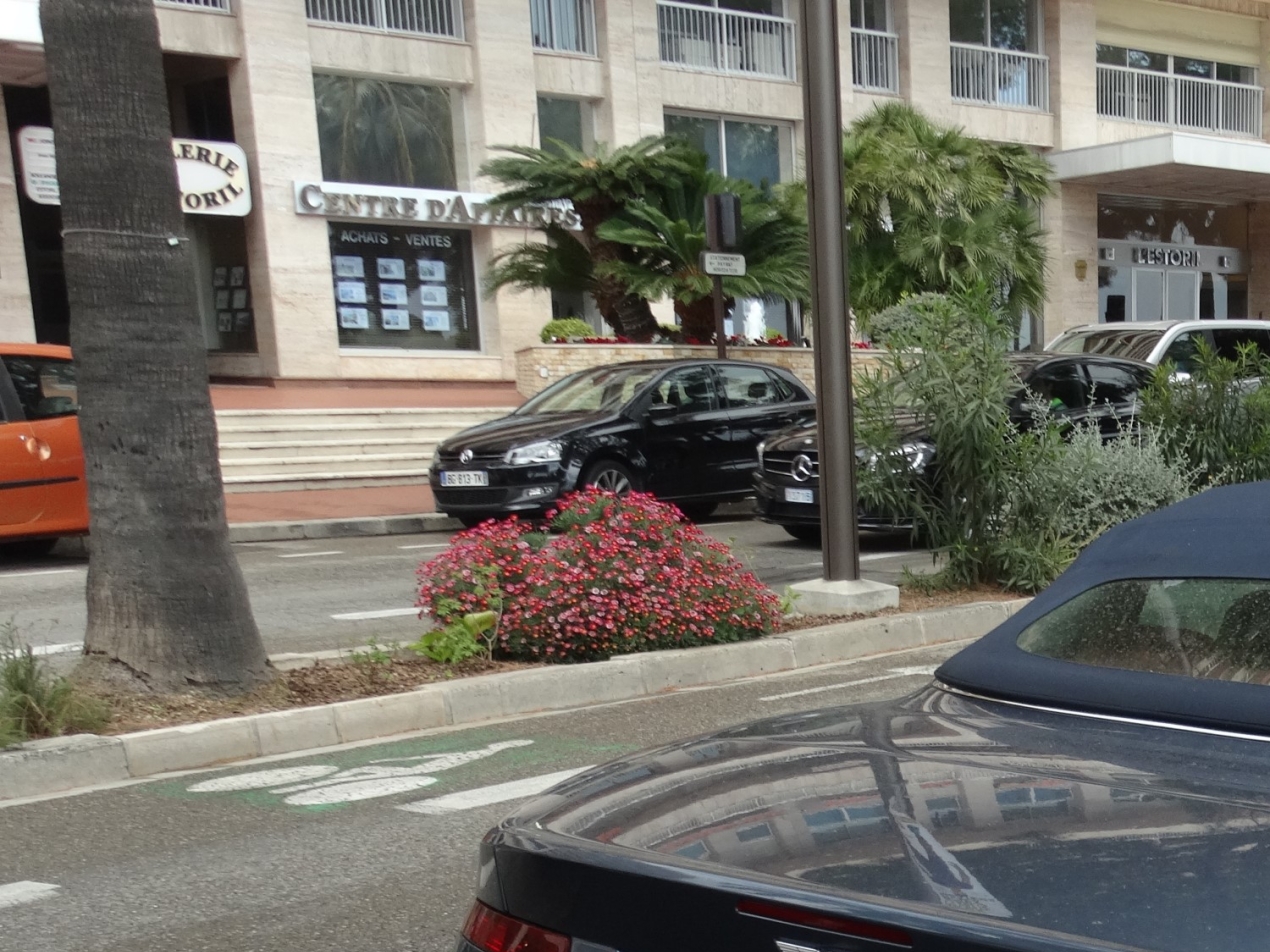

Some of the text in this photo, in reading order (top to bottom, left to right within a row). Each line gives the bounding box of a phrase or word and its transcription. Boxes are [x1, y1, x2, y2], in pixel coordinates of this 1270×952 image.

[174, 143, 239, 178] ERIE
[181, 182, 244, 209] ORIL
[341, 230, 388, 245] ACHATS
[406, 233, 452, 248] VENTES
